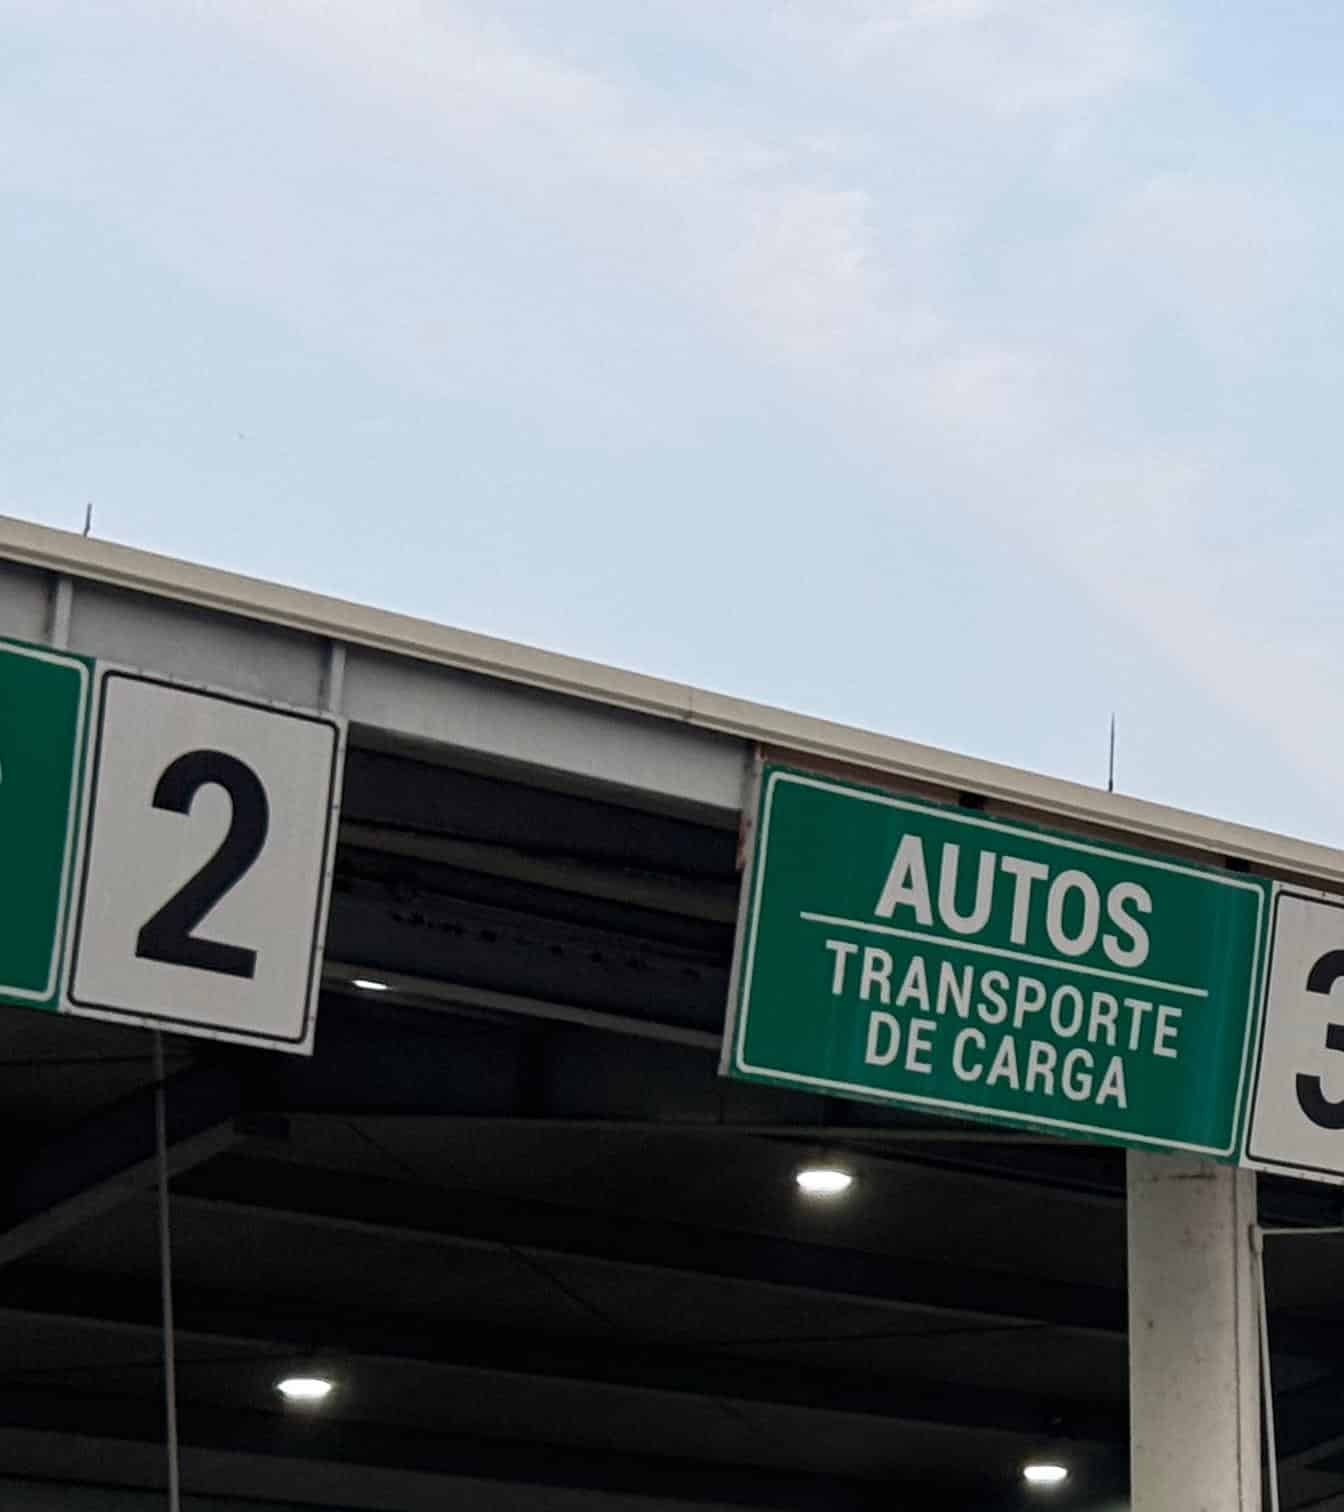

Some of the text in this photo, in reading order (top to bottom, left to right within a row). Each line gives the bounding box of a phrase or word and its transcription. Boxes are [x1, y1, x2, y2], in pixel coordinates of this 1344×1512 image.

[135, 750, 269, 979] 2
[875, 835, 1153, 968] AUTOS
[826, 940, 1182, 1058] TRANSPORTE
[865, 1012, 1127, 1108] DE CARGA
